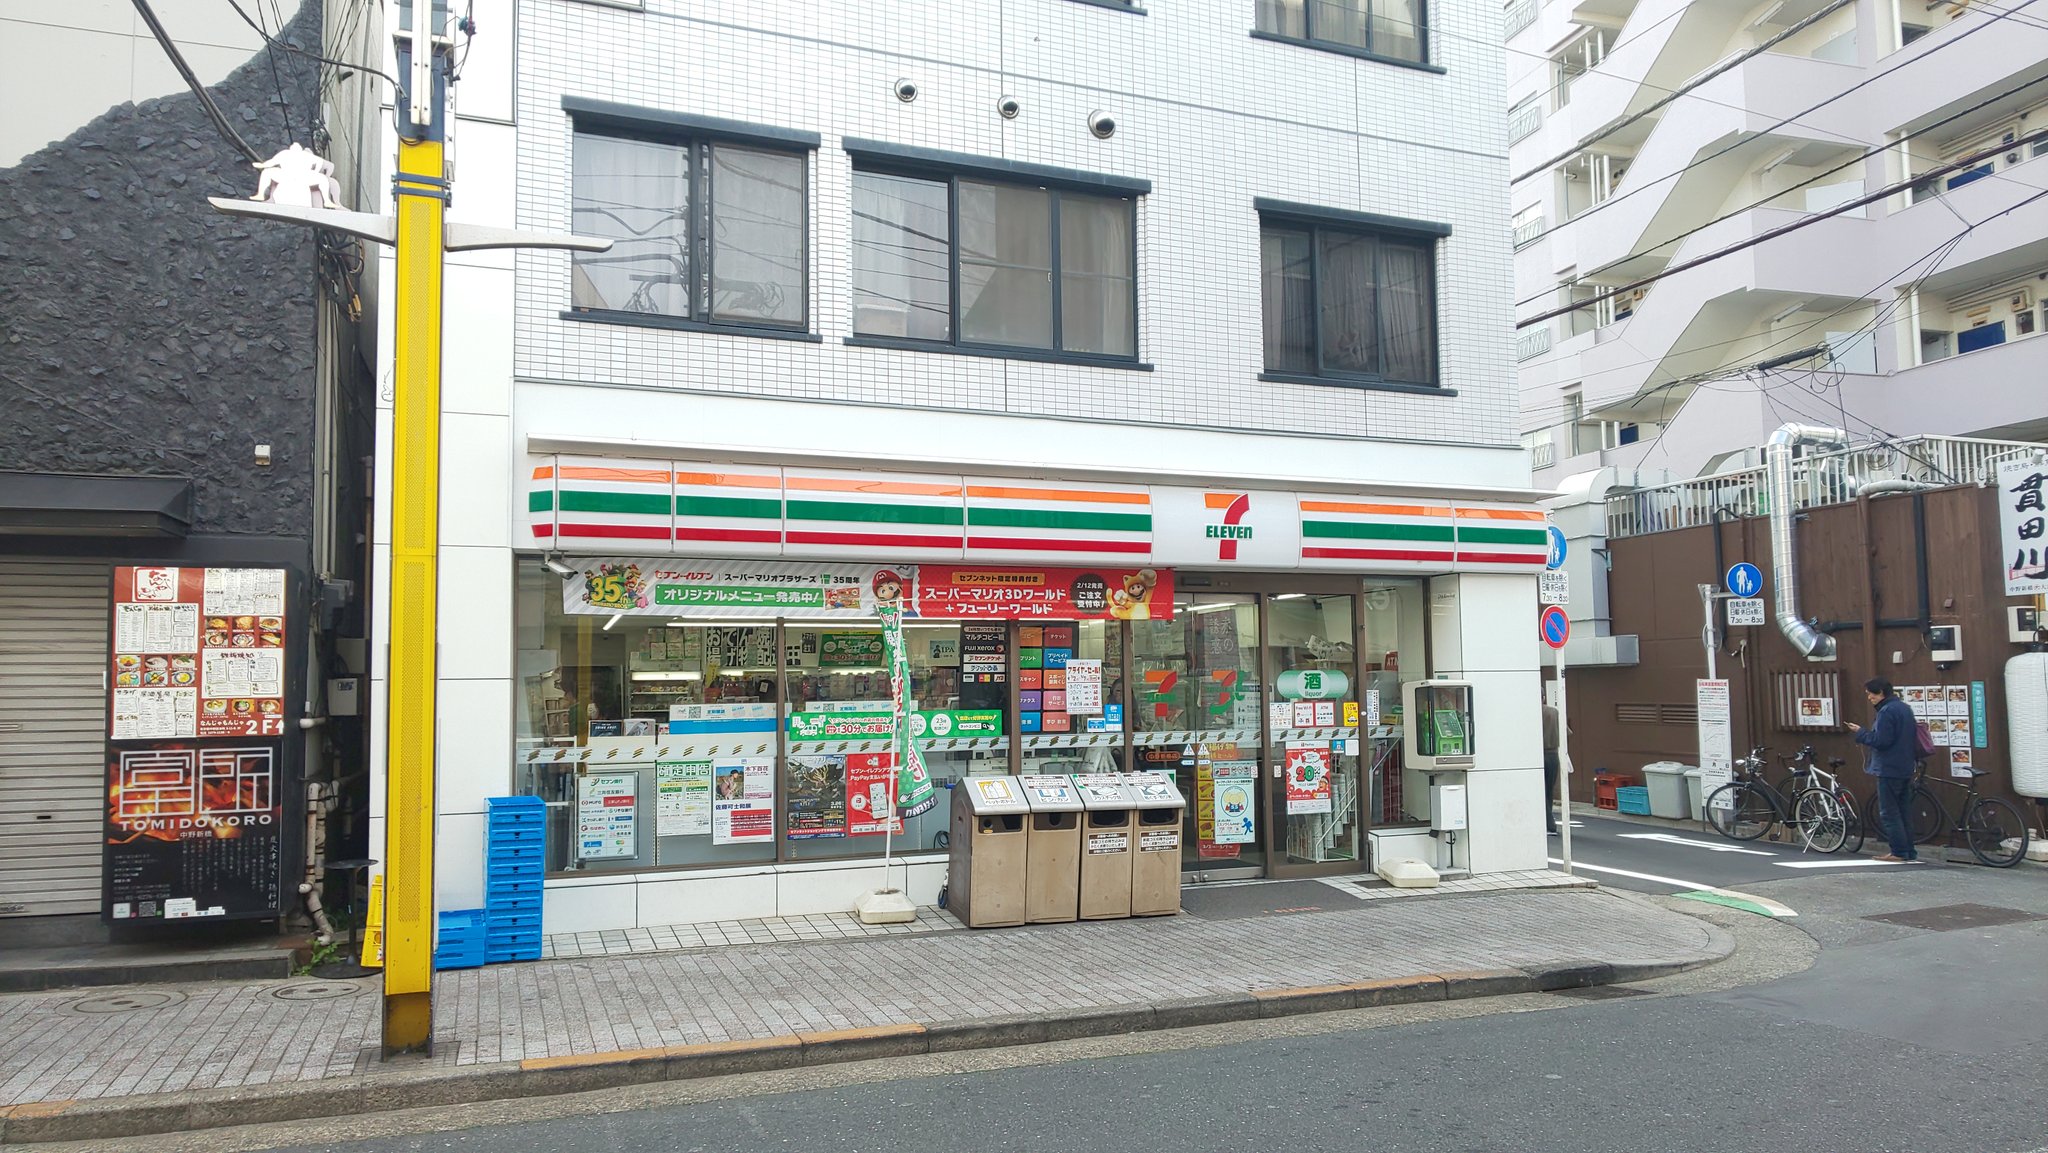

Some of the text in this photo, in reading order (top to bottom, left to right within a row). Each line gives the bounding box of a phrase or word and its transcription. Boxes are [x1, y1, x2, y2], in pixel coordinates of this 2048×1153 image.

[724, 573, 817, 583] スーパーマリオブラザーズ
[664, 588, 820, 604] オリジナルメニュー発売中!
[925, 587, 1067, 601] スーパーマリオ3Dワールド
[1078, 591, 1102, 599] ご注文
[956, 603, 1054, 615] フューリーワールド
[1304, 672, 1321, 690] 酒
[119, 814, 273, 832] TOMIDOKORO
[179, 830, 213, 839] 中野新橋
